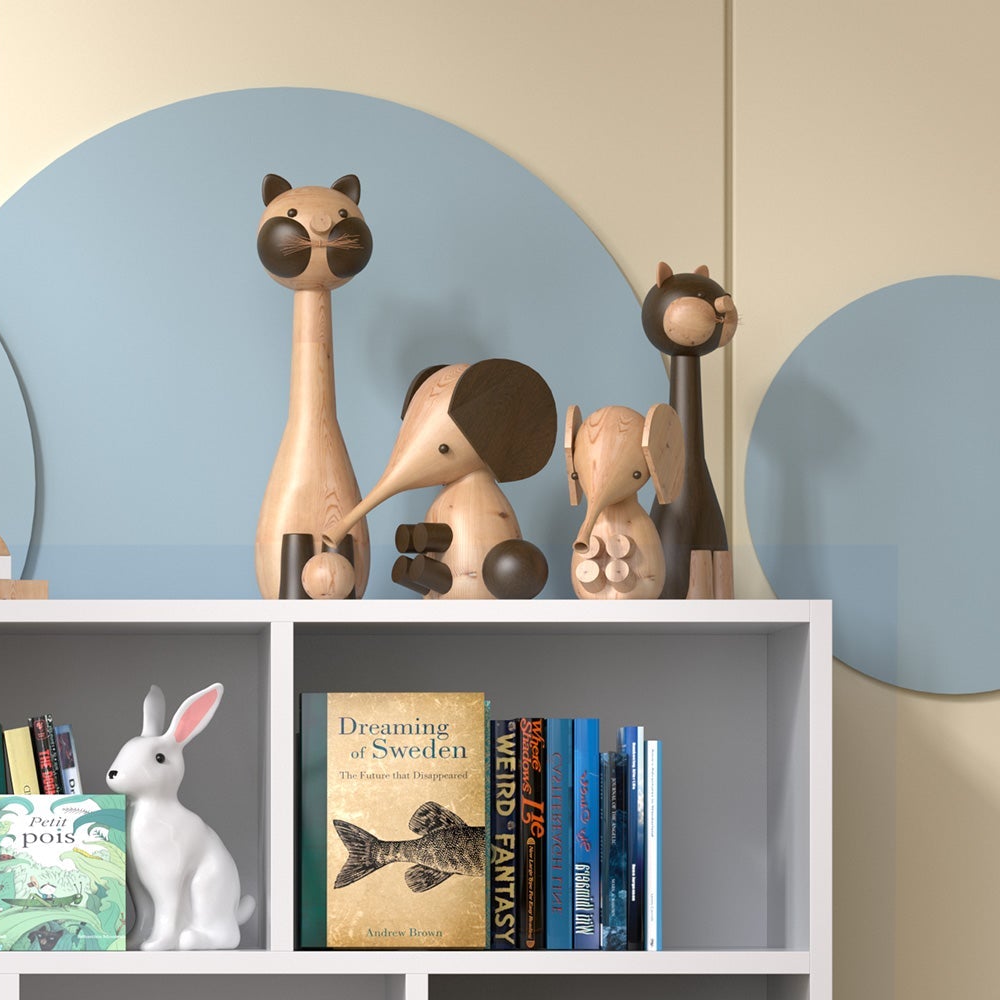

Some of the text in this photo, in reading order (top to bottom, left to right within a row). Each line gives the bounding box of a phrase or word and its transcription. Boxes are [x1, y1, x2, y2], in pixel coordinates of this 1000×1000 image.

[339, 717, 449, 740] Dreaming
[351, 738, 468, 759] of Sweden
[520, 718, 532, 794] Shadows
[531, 720, 546, 772] Where
[39, 749, 53, 769] THE
[340, 771, 468, 781] The Future that Disappeared
[29, 816, 67, 827] Petit
[22, 828, 75, 848] pois
[495, 733, 516, 945] WEIRD FANTASY
[365, 928, 443, 937] Andrew Brown
